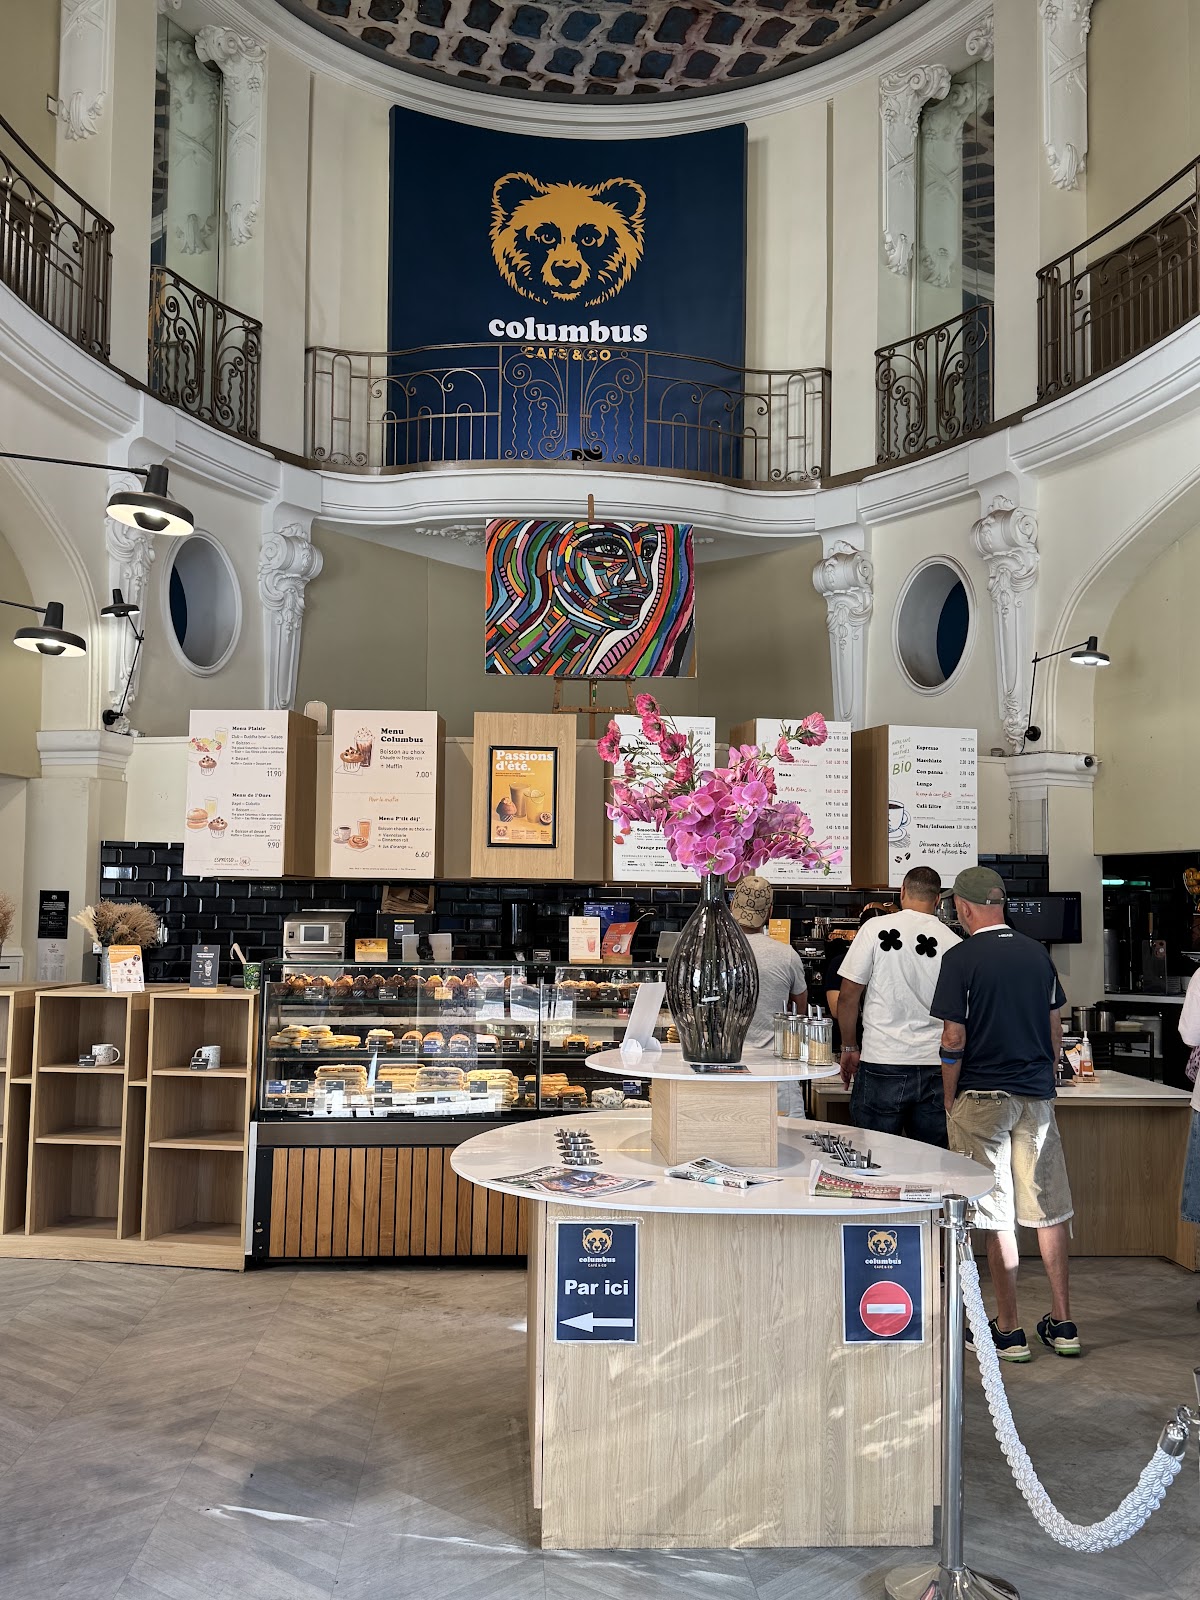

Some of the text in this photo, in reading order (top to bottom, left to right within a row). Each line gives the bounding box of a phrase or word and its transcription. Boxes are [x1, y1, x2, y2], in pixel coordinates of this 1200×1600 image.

[488, 317, 648, 342] columbus
[496, 751, 553, 760] Passions
[496, 761, 531, 770] d'été.
[565, 1280, 629, 1295] Par ici
